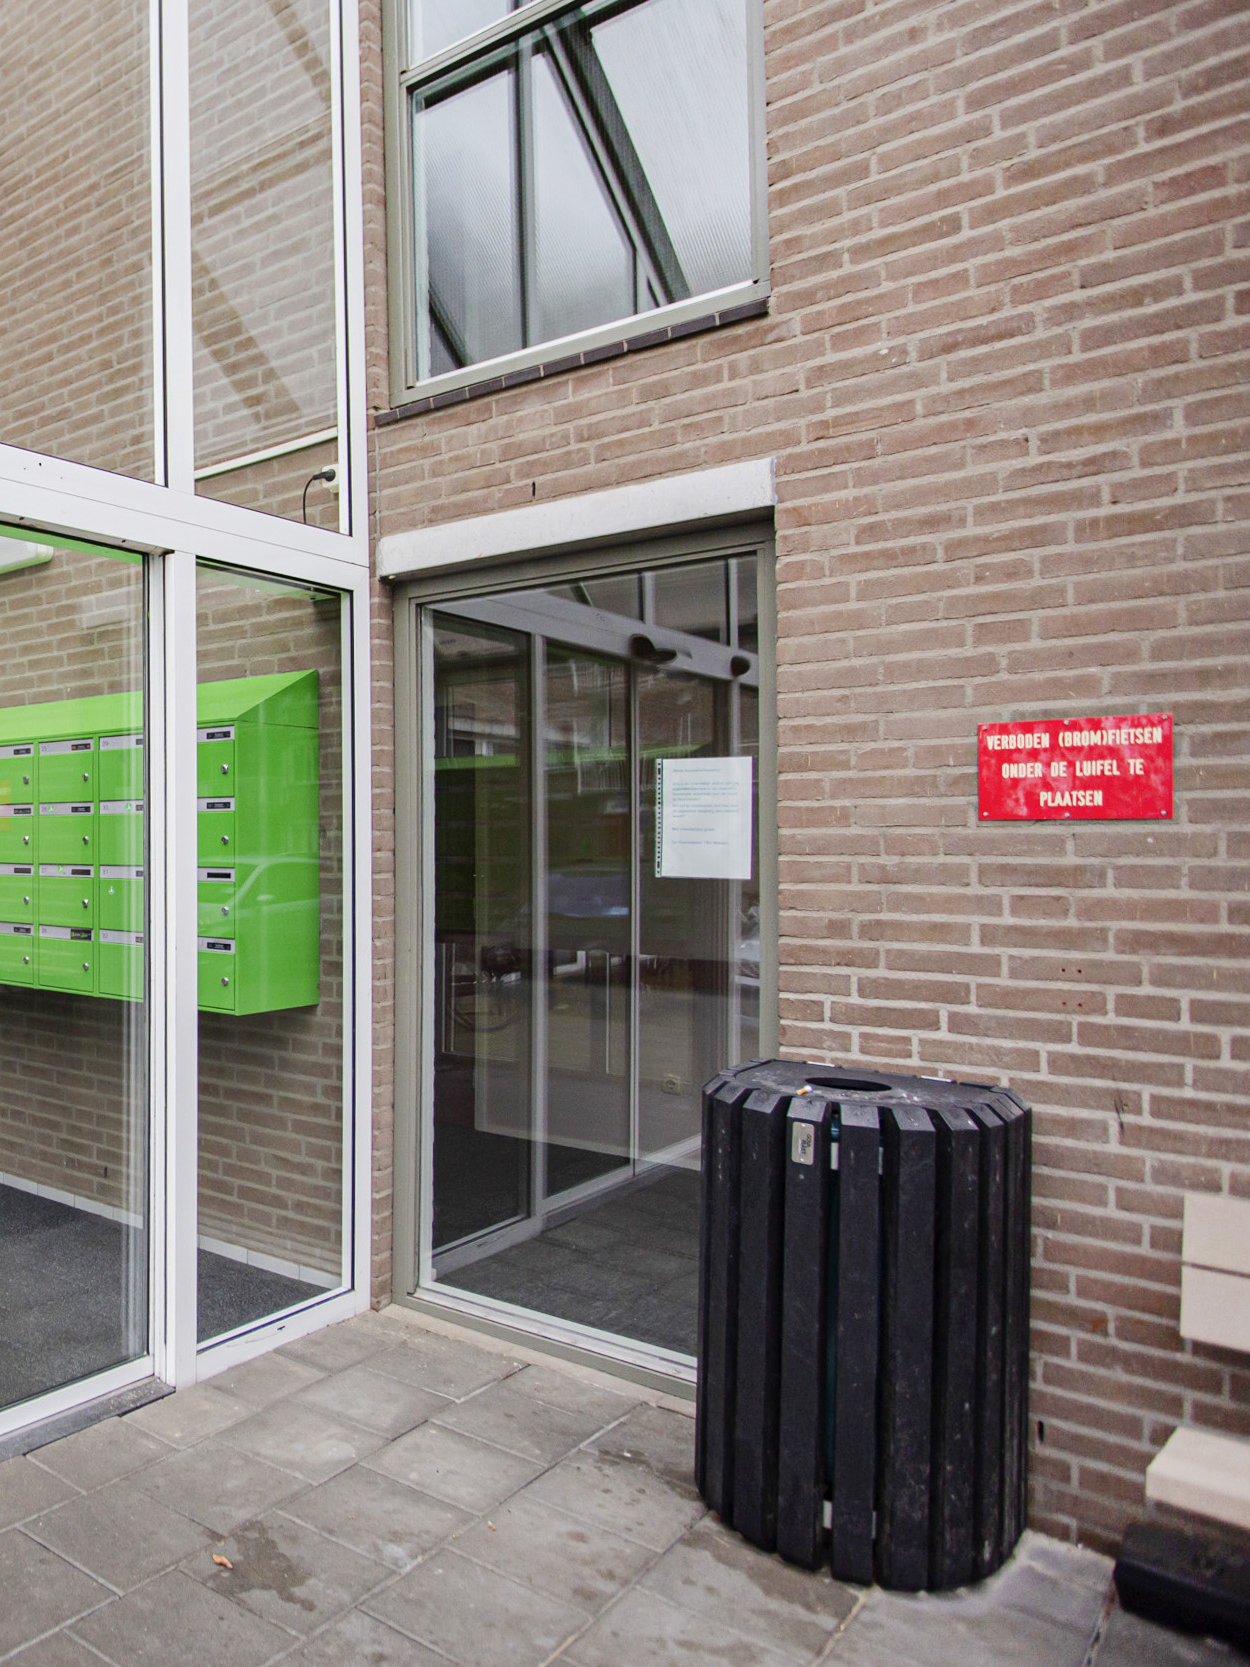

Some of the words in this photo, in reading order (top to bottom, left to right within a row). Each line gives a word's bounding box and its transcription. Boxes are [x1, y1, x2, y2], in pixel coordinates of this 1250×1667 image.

[986, 732, 1050, 750] VERBODEN
[1058, 727, 1162, 747] (BROM)FIETSEN
[1001, 762, 1042, 778] ONDER
[1050, 761, 1067, 777] DE
[1075, 760, 1120, 777] LUIFEL
[1128, 758, 1144, 775] TE
[1040, 790, 1103, 807] PLAATSEN
